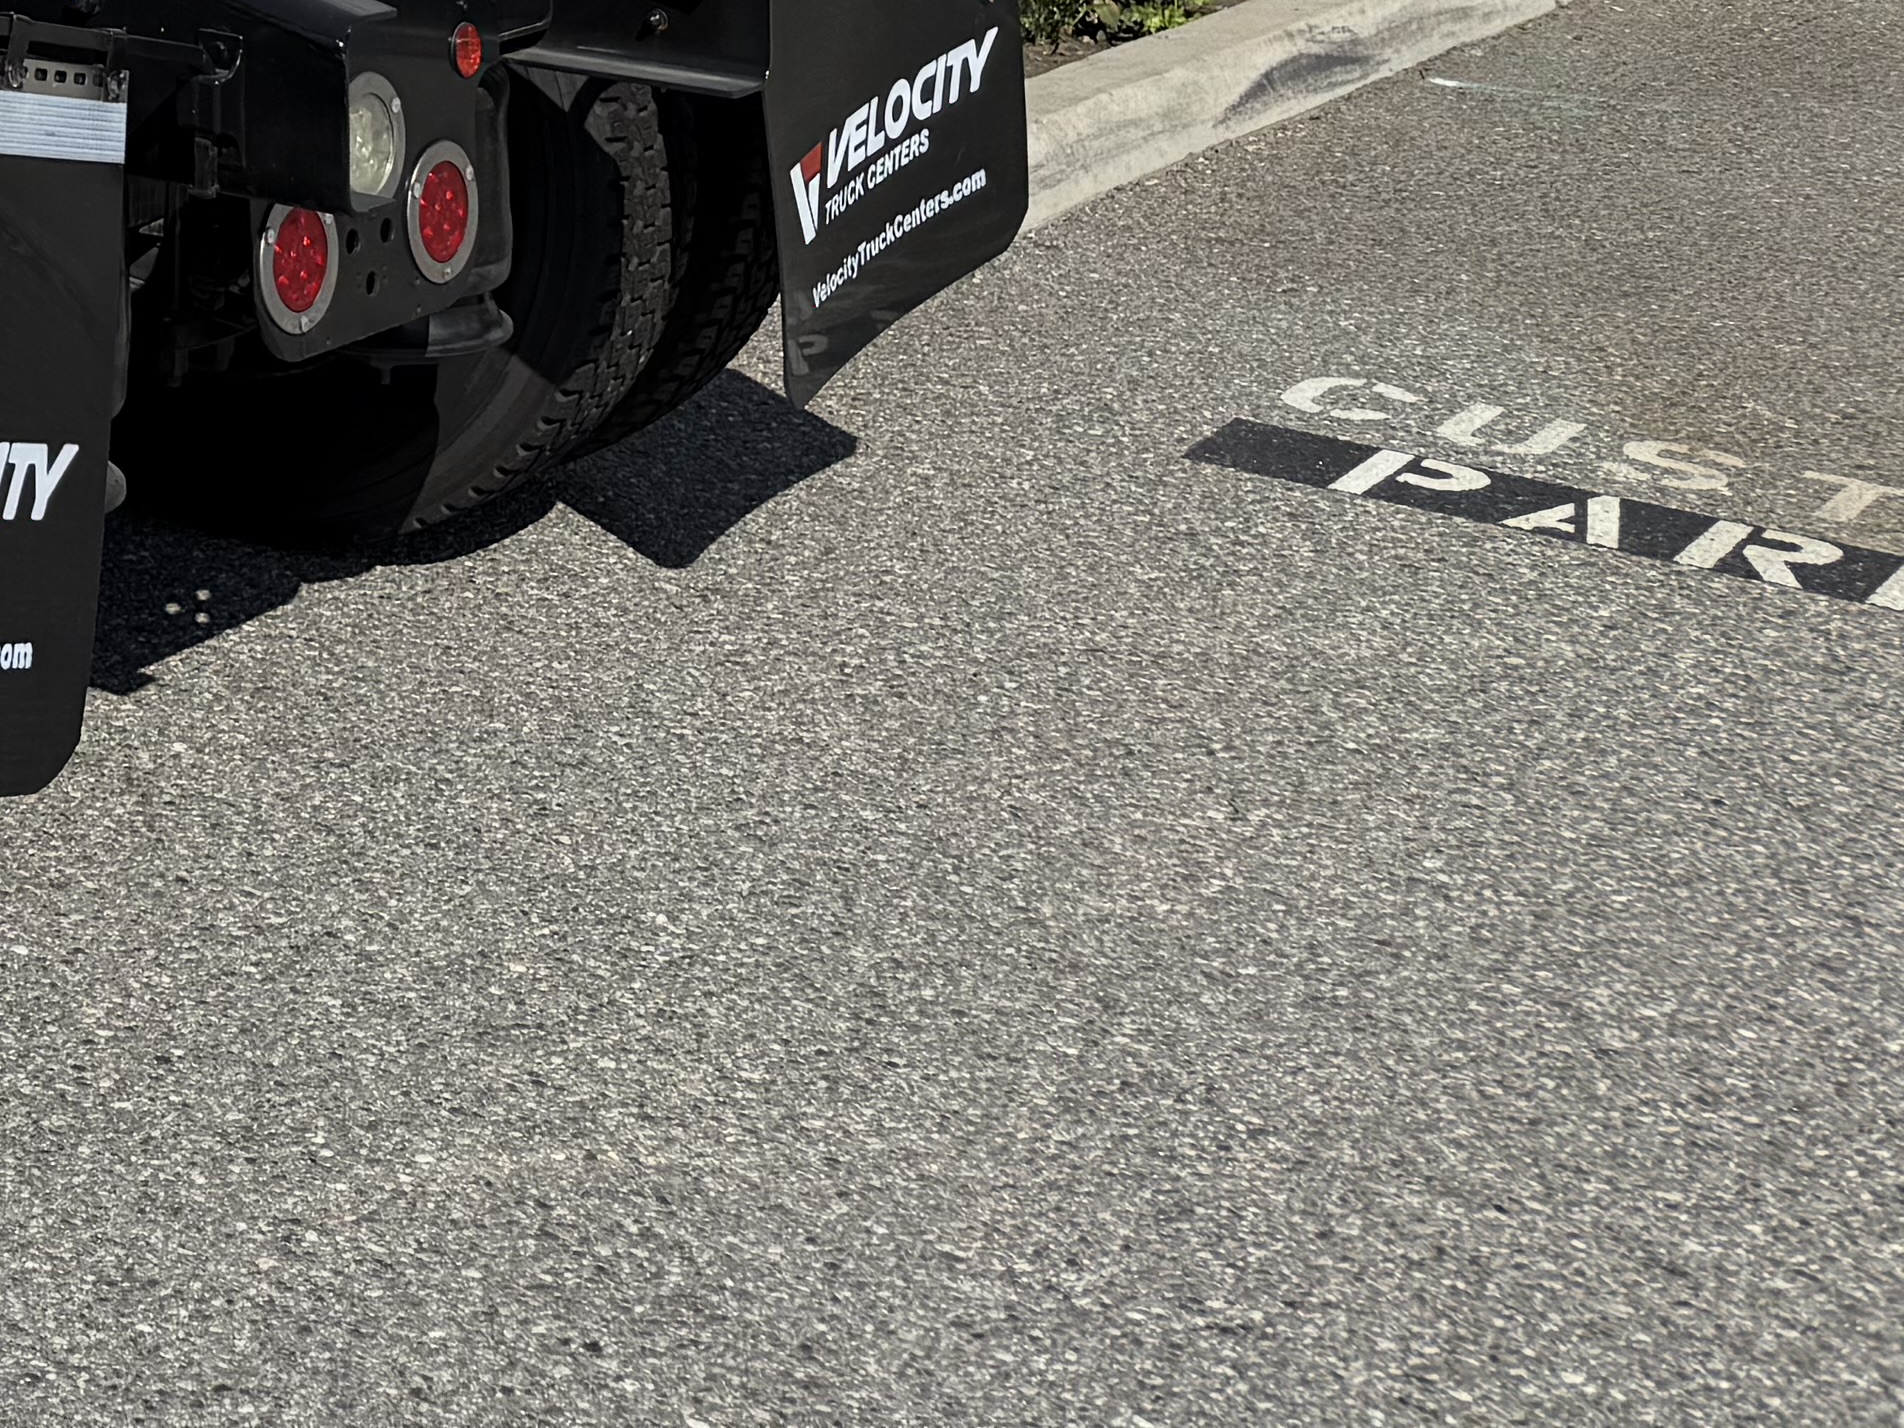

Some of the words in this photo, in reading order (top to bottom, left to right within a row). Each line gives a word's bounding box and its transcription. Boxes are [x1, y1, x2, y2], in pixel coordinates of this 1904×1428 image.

[825, 172, 865, 224] TRUCK
[867, 128, 930, 190] CENTERS
[827, 26, 998, 188] VELOCITY
[812, 169, 987, 308] VelocityTruckCenters.com
